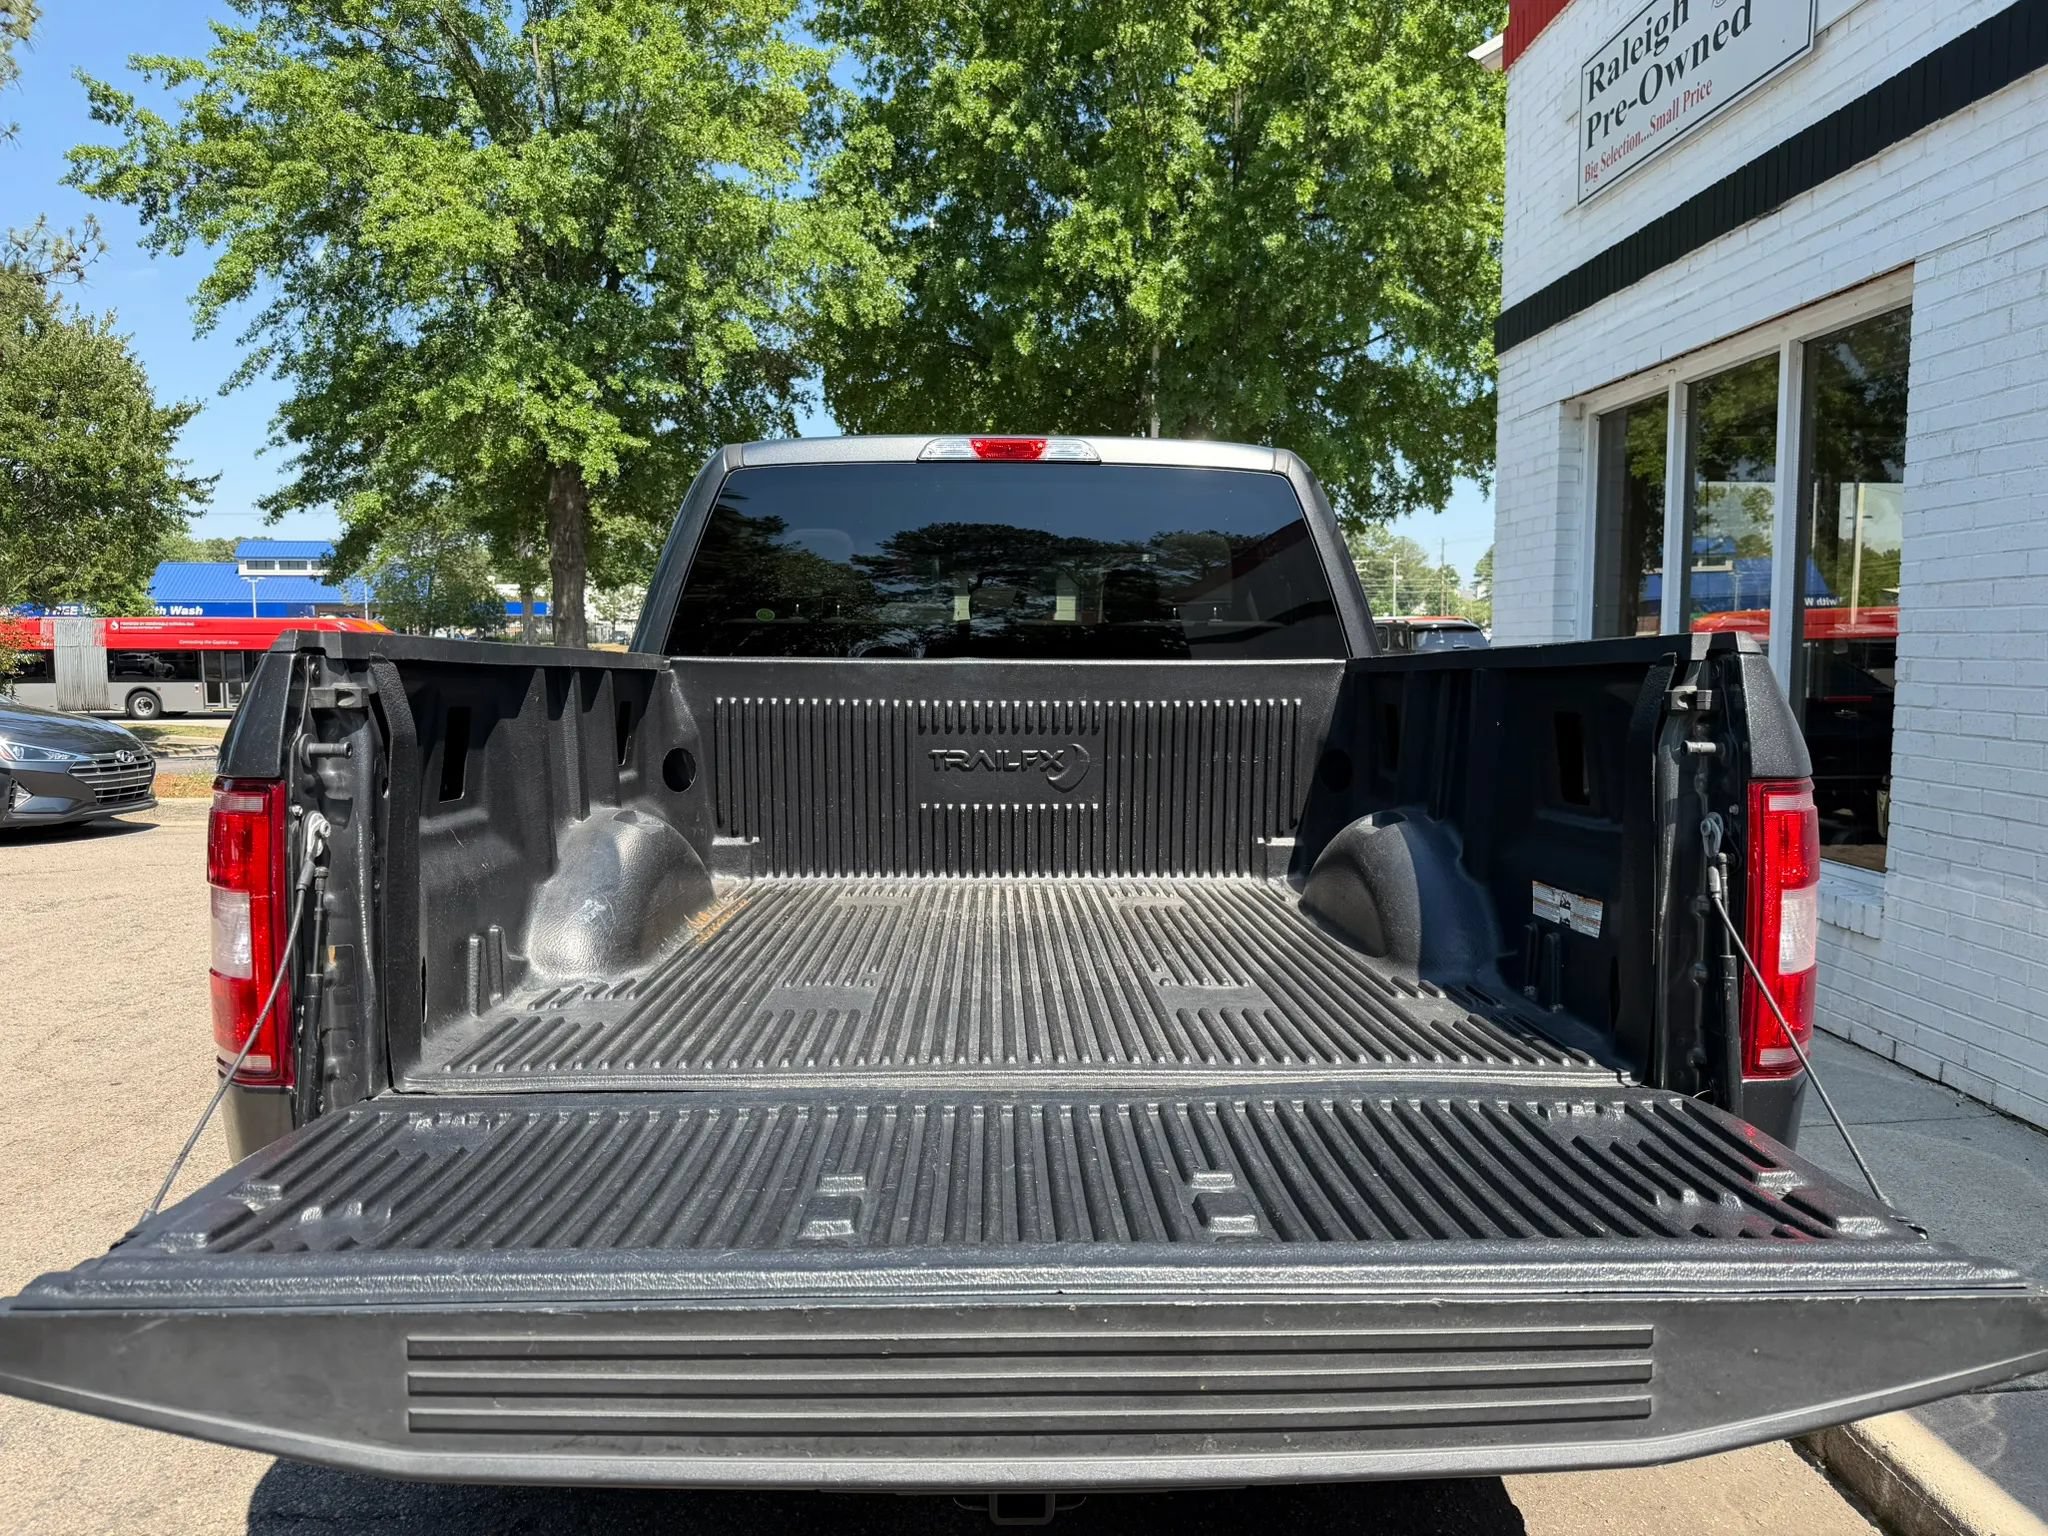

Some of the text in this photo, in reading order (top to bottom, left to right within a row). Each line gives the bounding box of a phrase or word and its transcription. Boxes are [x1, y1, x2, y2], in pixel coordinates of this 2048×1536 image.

[1585, 0, 1689, 104] Raleigh
[1586, 0, 1752, 151] Pre-Owned
[1584, 161, 1599, 183] Big
[1682, 79, 1713, 113] Price
[170, 605, 203, 616] Wash
[928, 749, 1065, 772] TRAILFX
